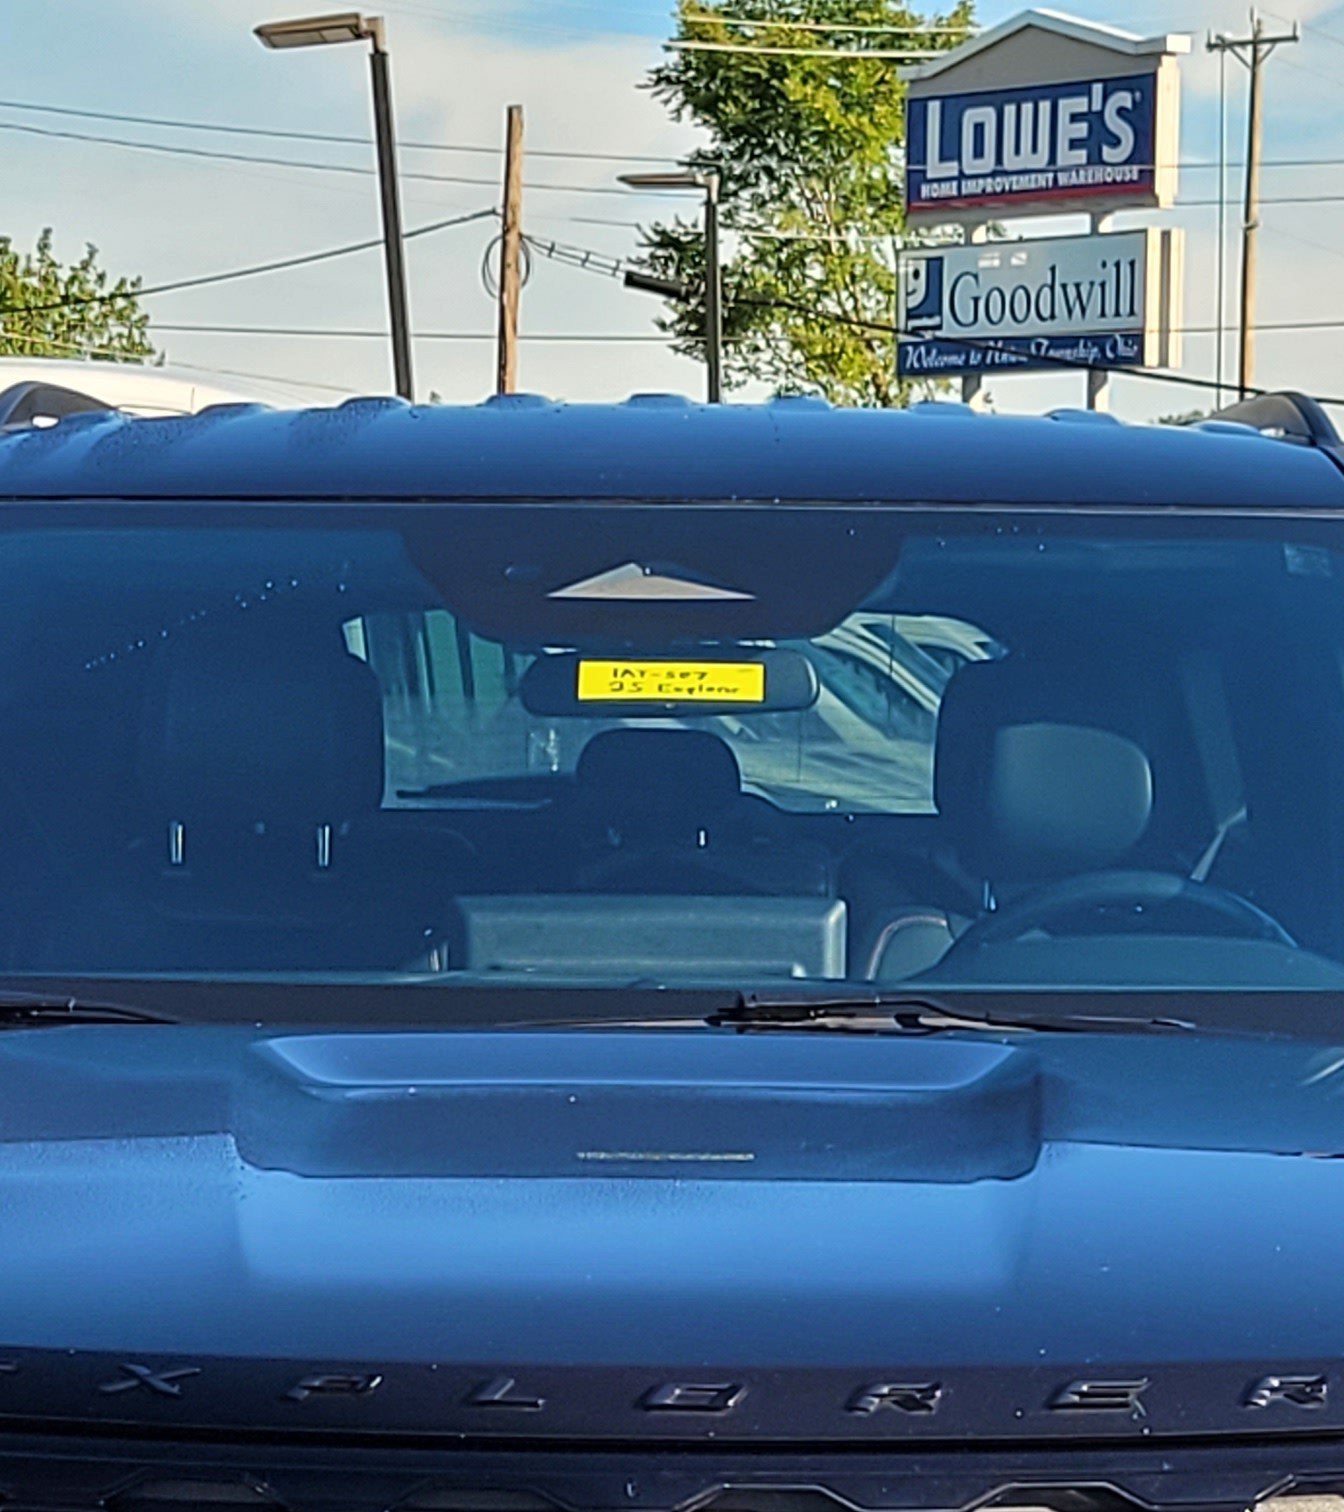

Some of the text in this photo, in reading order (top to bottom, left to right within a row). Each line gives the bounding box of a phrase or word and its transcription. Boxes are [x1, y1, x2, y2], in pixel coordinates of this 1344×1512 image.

[925, 82, 1136, 180] LOWE'S
[920, 165, 1139, 200] HOME IMPROVEMENT WAREHOUSE
[948, 258, 1140, 328] Goodwill
